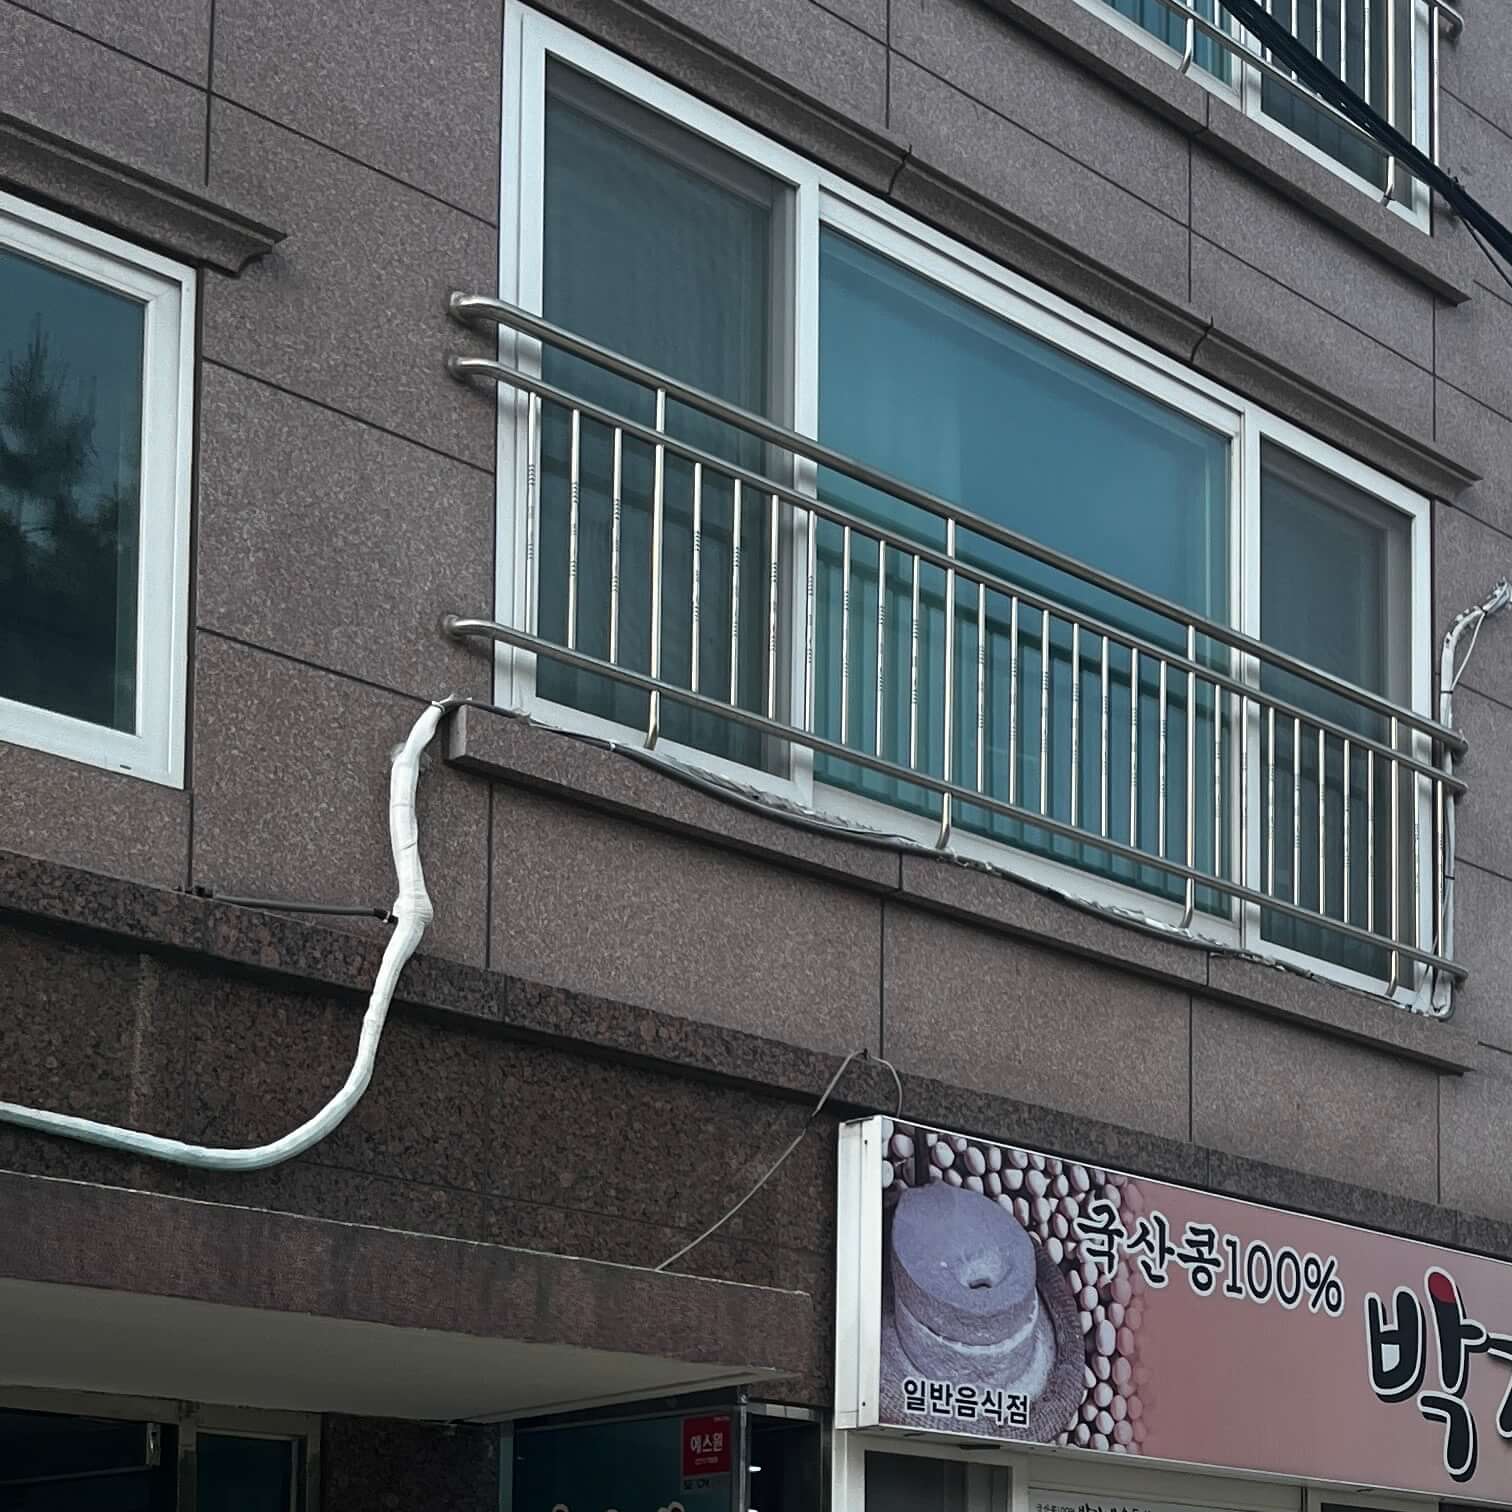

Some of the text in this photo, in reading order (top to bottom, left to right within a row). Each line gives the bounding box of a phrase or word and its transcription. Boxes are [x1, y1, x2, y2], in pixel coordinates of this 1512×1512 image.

[1074, 1199, 1344, 1317] 국산콩100%
[902, 1378, 1032, 1428] 일반음식점
[690, 1432, 724, 1454] 에스원
